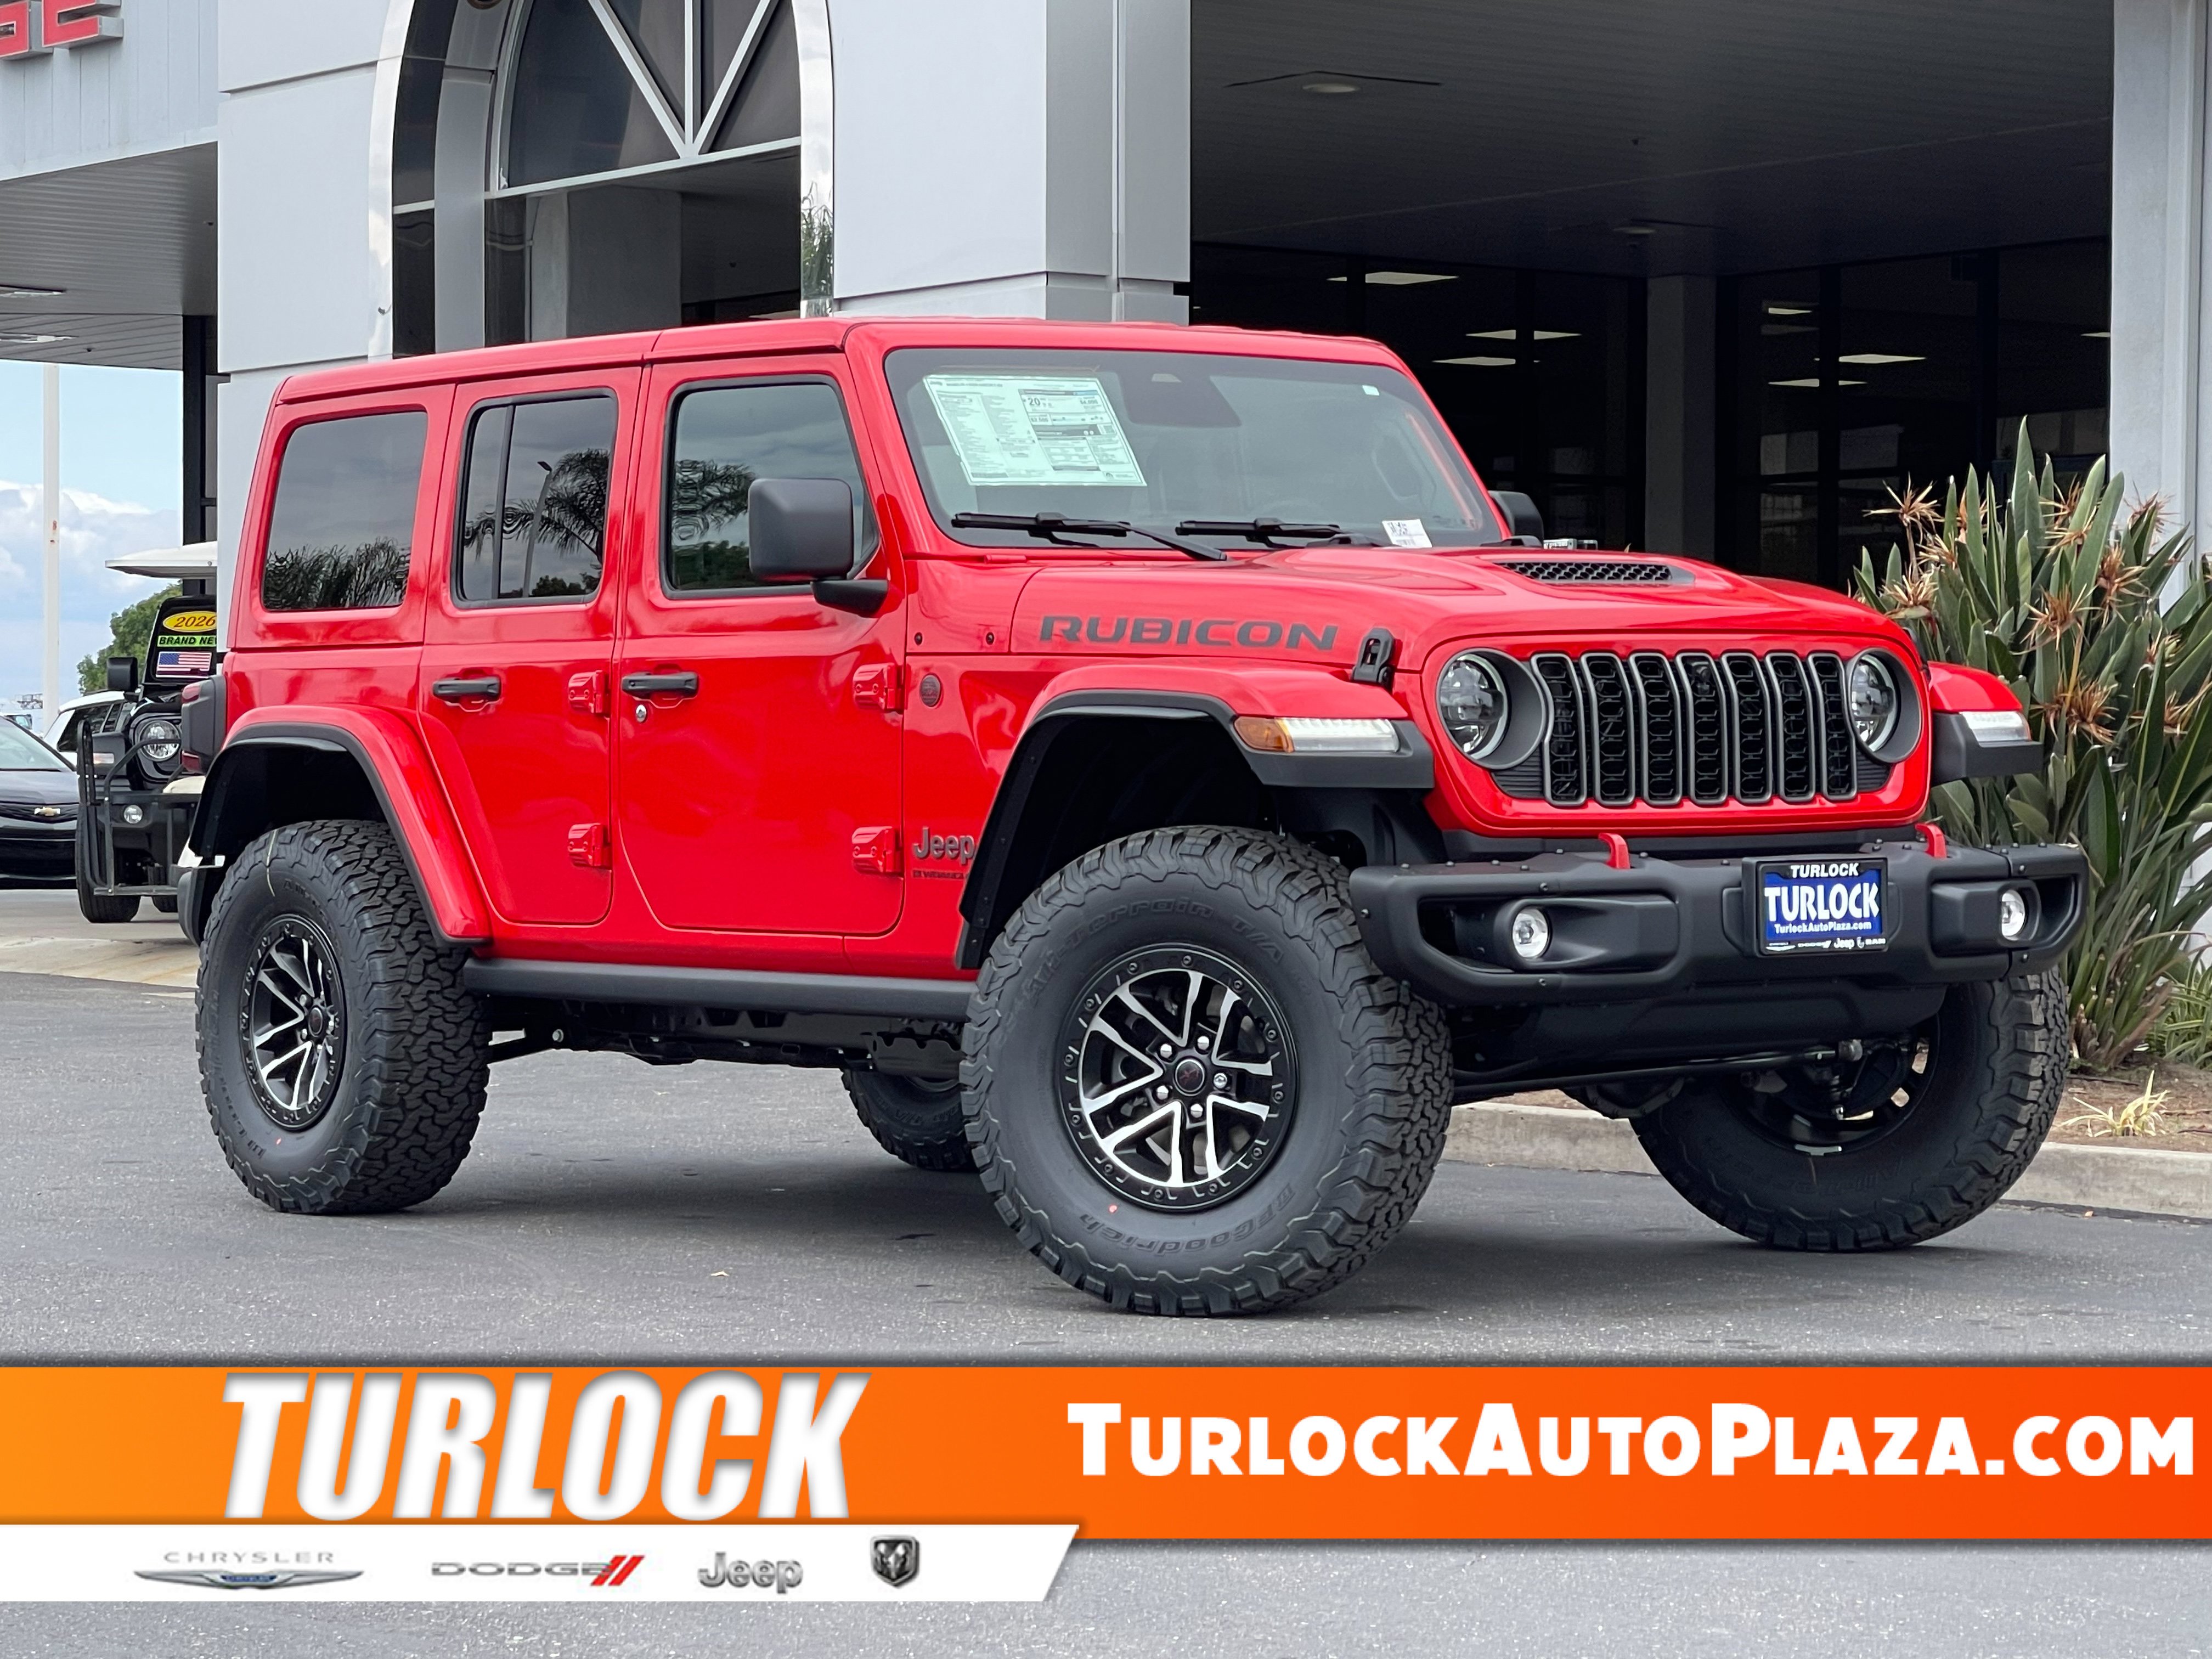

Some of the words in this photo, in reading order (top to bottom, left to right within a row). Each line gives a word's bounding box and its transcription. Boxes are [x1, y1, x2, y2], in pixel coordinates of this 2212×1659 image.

[174, 616, 216, 628] 2026
[1039, 616, 1338, 650] RUBICON
[159, 636, 196, 645] BRAND
[199, 636, 217, 645] NE
[913, 826, 975, 865] Jeep
[1790, 862, 1859, 878] TURLOCK
[1764, 882, 1879, 922] TURLOCK
[1774, 921, 1872, 934] TurlockAutoPlaza.com
[1834, 938, 1854, 950] Jeep
